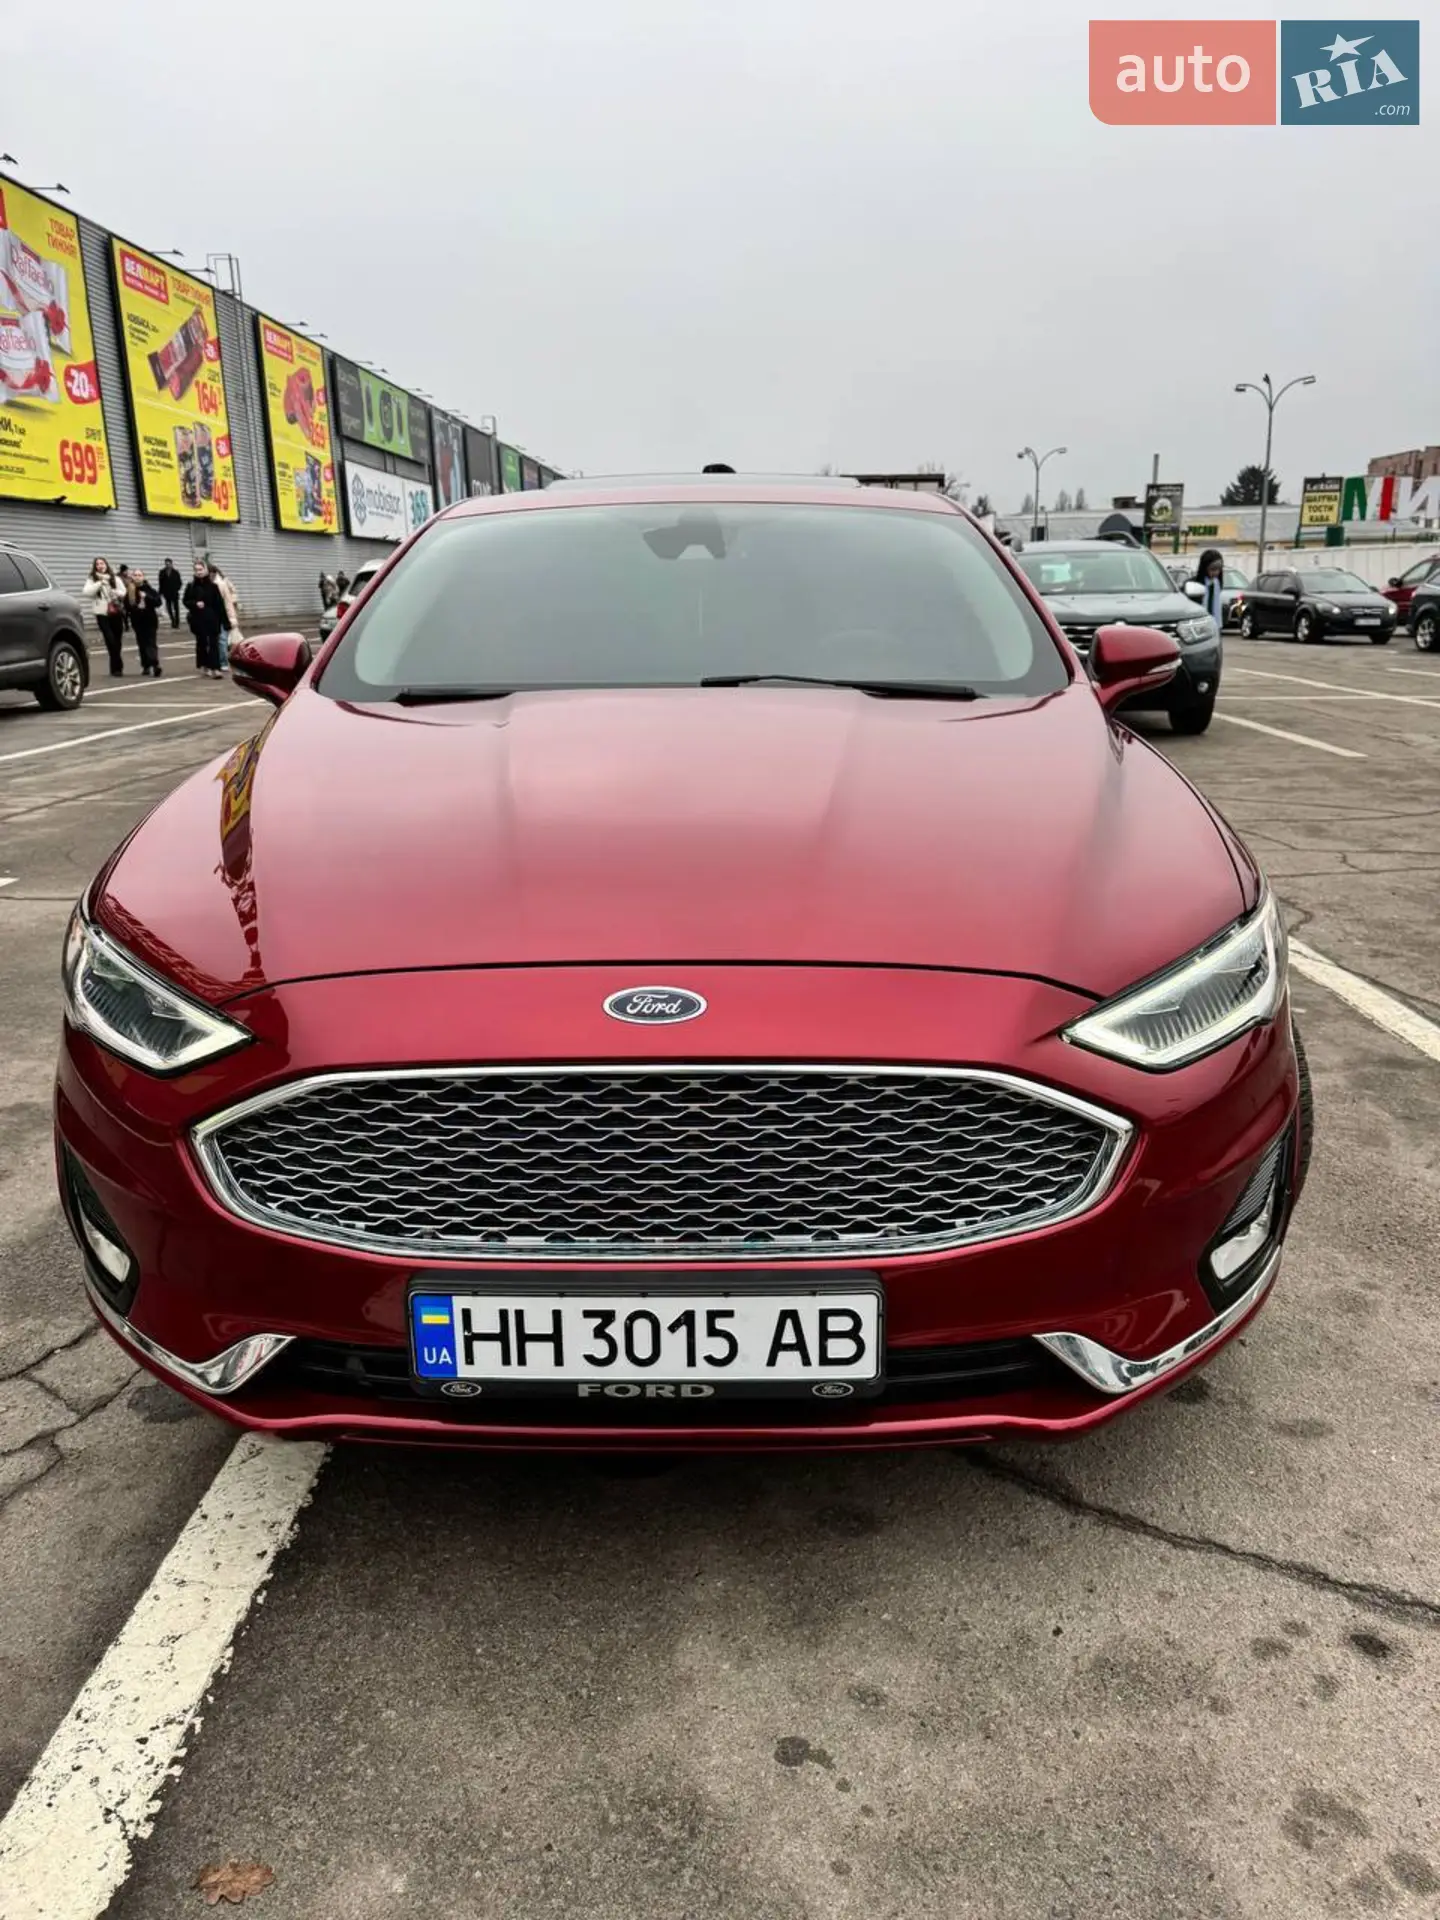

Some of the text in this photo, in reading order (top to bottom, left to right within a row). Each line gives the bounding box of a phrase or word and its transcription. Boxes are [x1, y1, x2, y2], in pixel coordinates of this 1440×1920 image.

[0, 329, 37, 353] affaello
[60, 438, 97, 485] 699
[1308, 504, 1334, 513] ТОСТИ
[626, 993, 682, 1014] Ford
[461, 1308, 867, 1368] HH 3015 AB
[424, 1347, 453, 1365] UA
[577, 1383, 715, 1398] FORD
